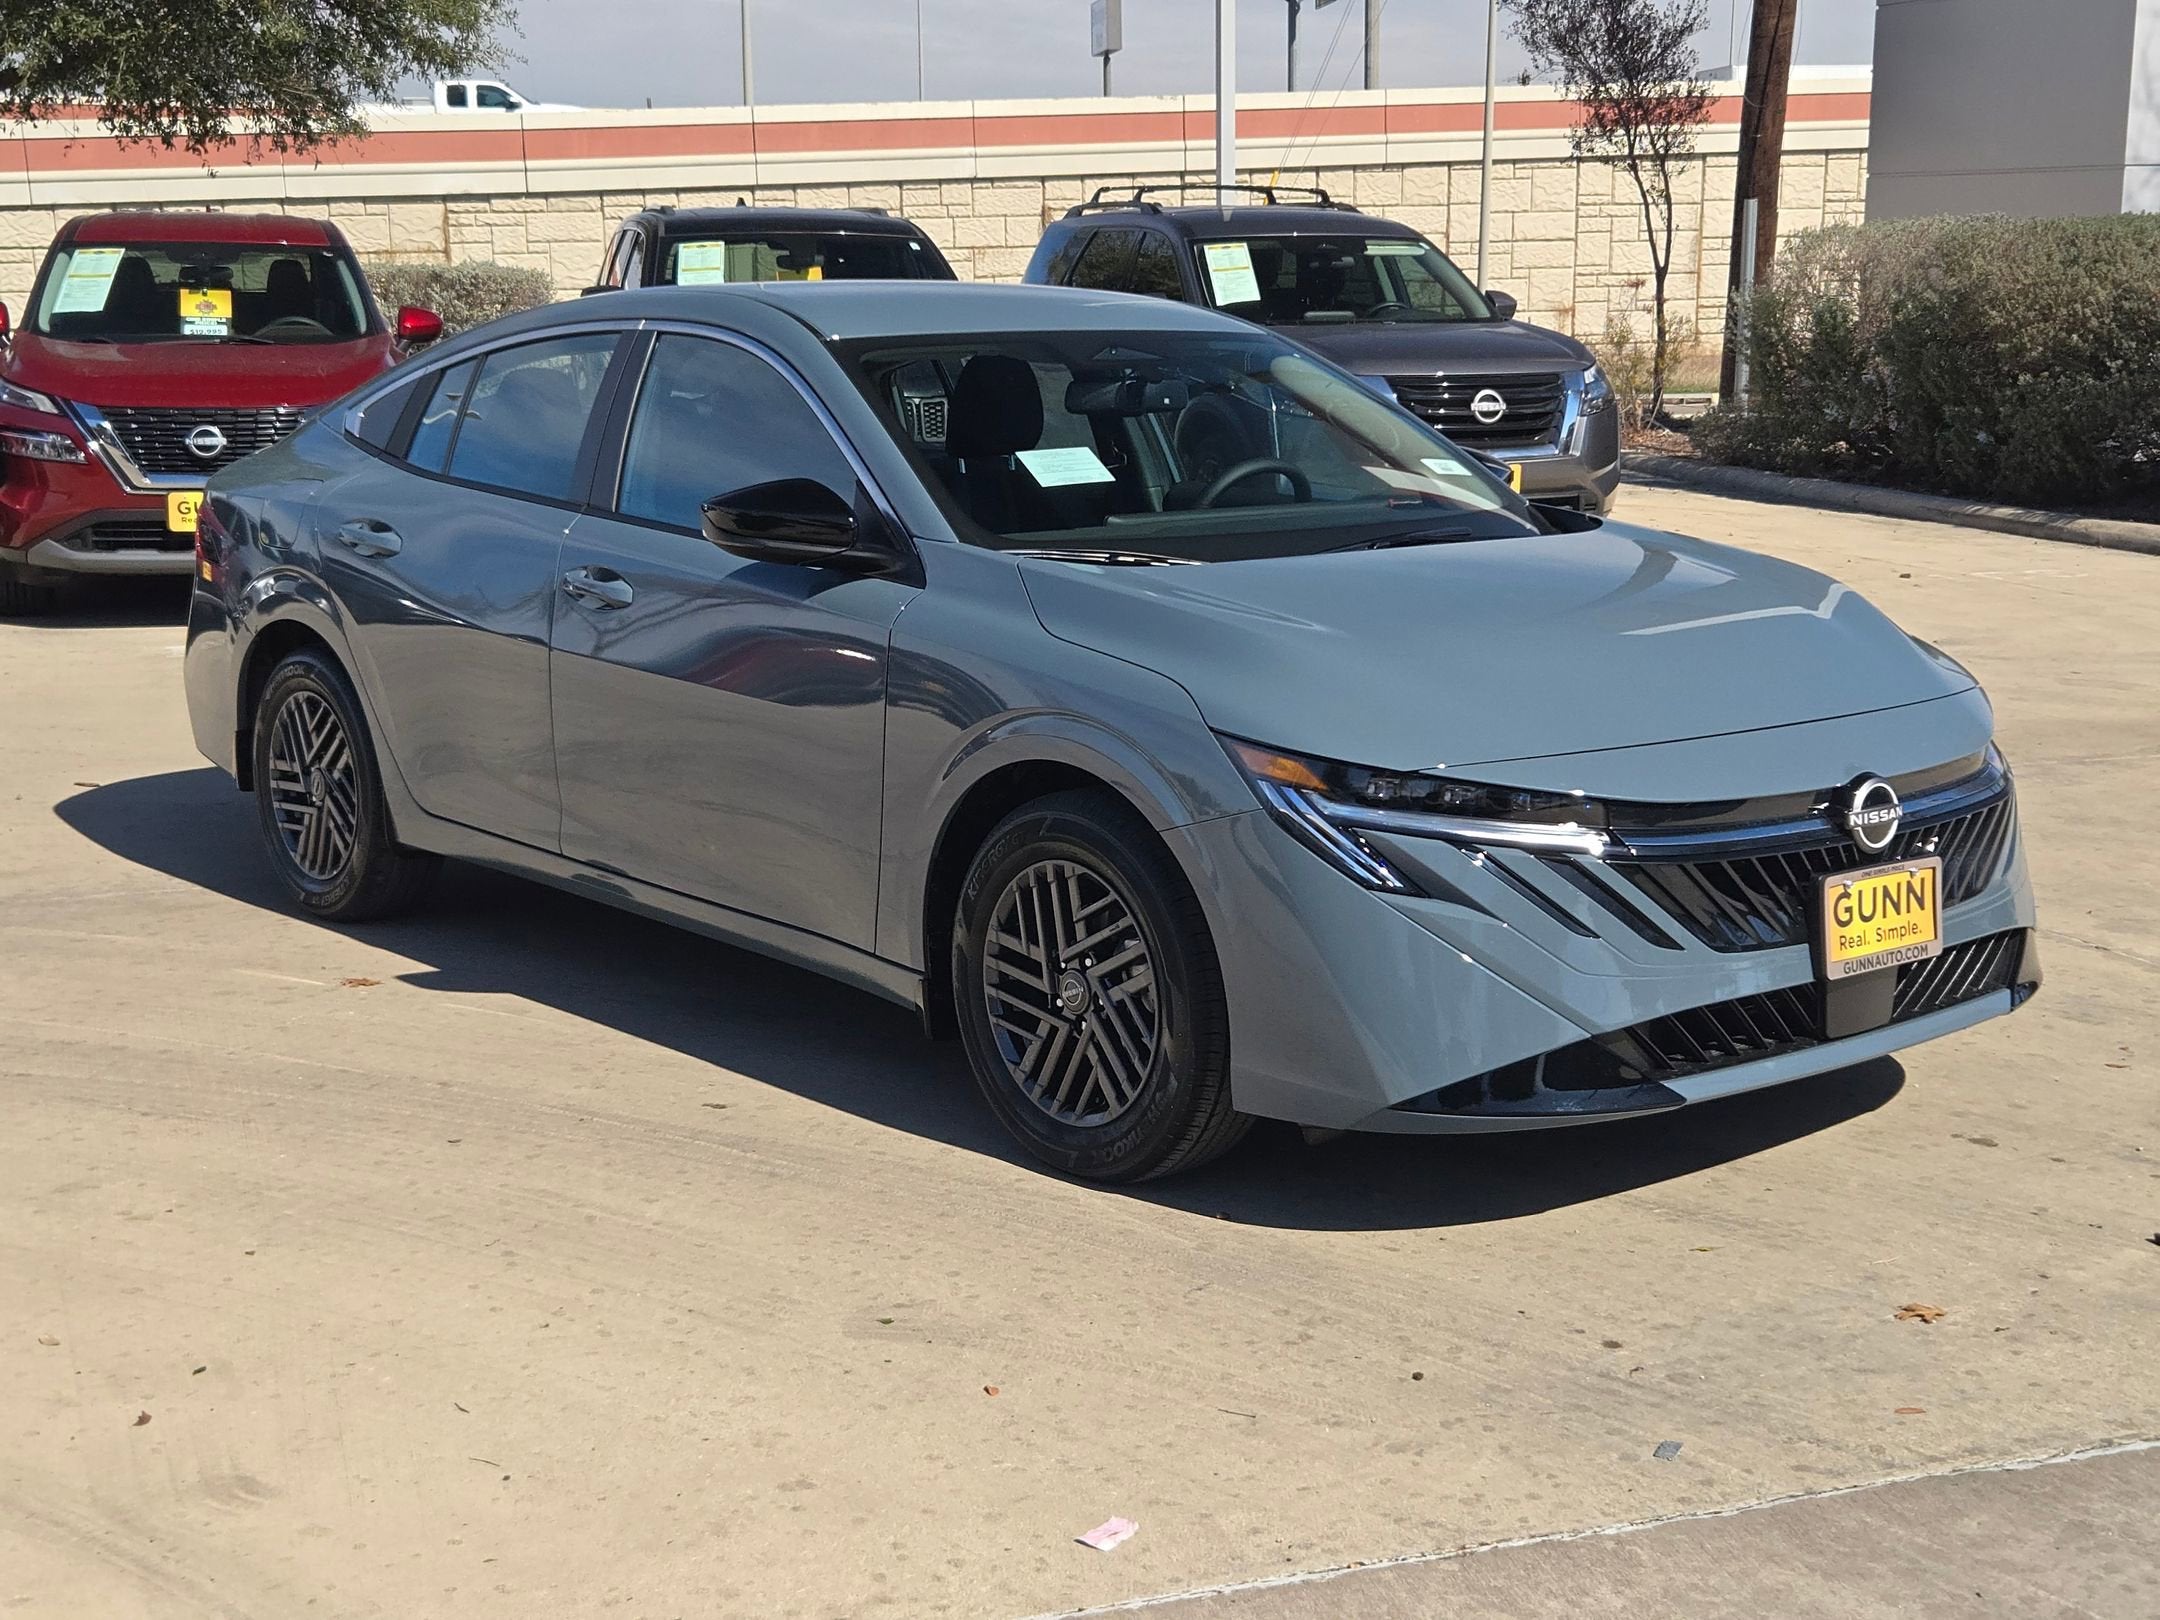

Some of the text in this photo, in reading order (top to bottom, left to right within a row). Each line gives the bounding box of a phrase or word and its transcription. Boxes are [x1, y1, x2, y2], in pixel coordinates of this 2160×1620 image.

[1850, 805, 1903, 826] NISSAN
[1833, 877, 1926, 928] GUNN
[1839, 920, 1923, 951] Real. Simple.
[1843, 944, 1929, 975] GUNNAUTO.COM
